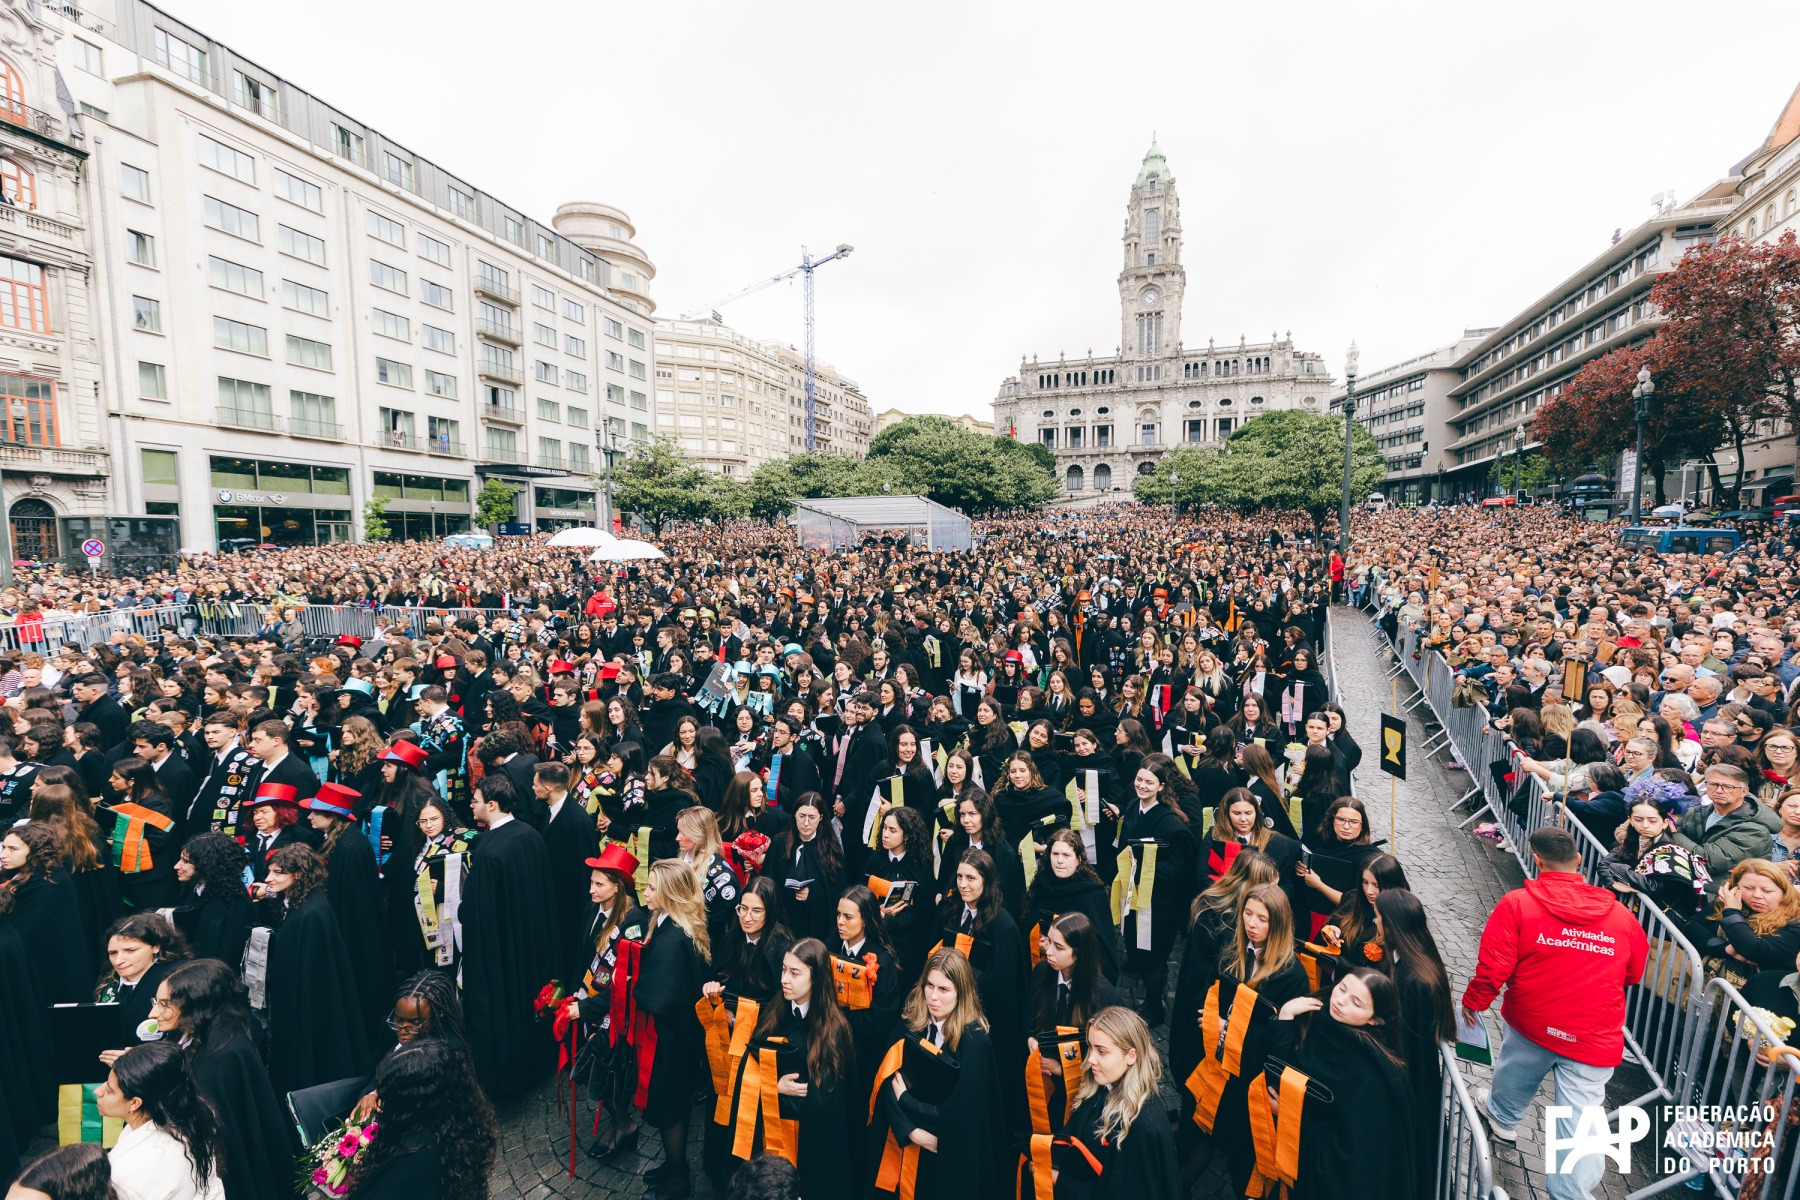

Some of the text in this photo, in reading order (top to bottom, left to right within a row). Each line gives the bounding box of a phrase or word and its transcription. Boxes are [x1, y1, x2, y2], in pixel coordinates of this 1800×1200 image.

[236, 493, 265, 503] BMcor
[1536, 932, 1615, 956] Académicas
[1561, 927, 1616, 944] Atividades
